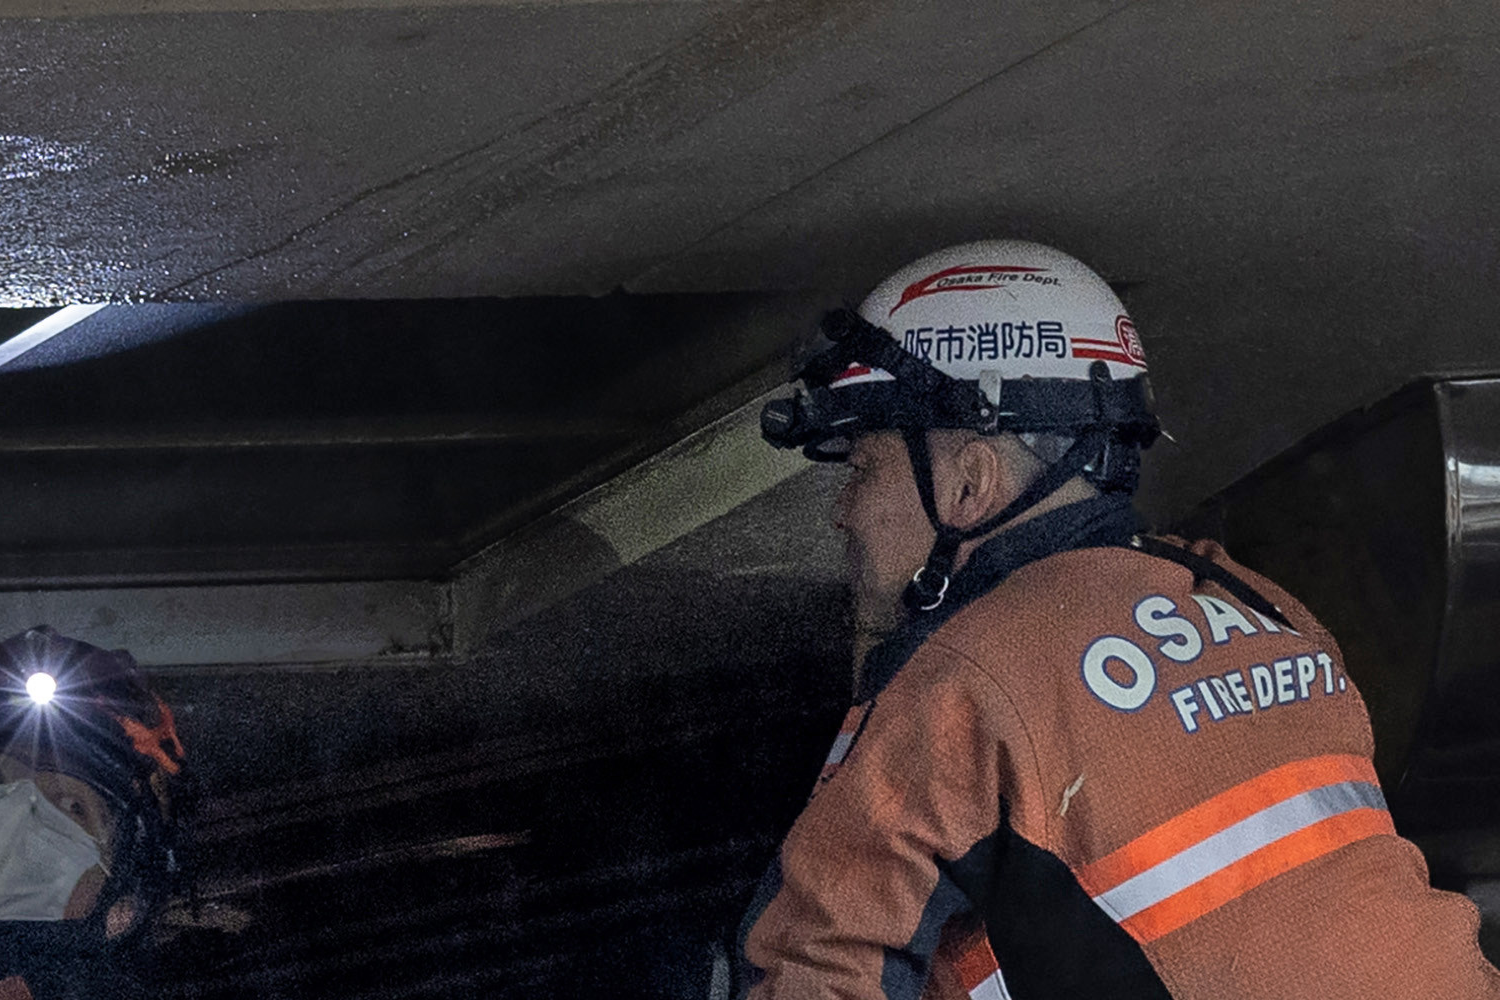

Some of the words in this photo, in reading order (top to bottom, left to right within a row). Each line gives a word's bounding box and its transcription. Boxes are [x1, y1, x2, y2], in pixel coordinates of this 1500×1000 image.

[937, 273, 983, 287] Osaka
[987, 273, 1018, 283] Fire
[1022, 274, 1062, 287] Dept.
[900, 321, 1066, 363] 阪市消防局
[1170, 671, 1253, 732] FIRE
[1251, 652, 1346, 709] DEPT.
